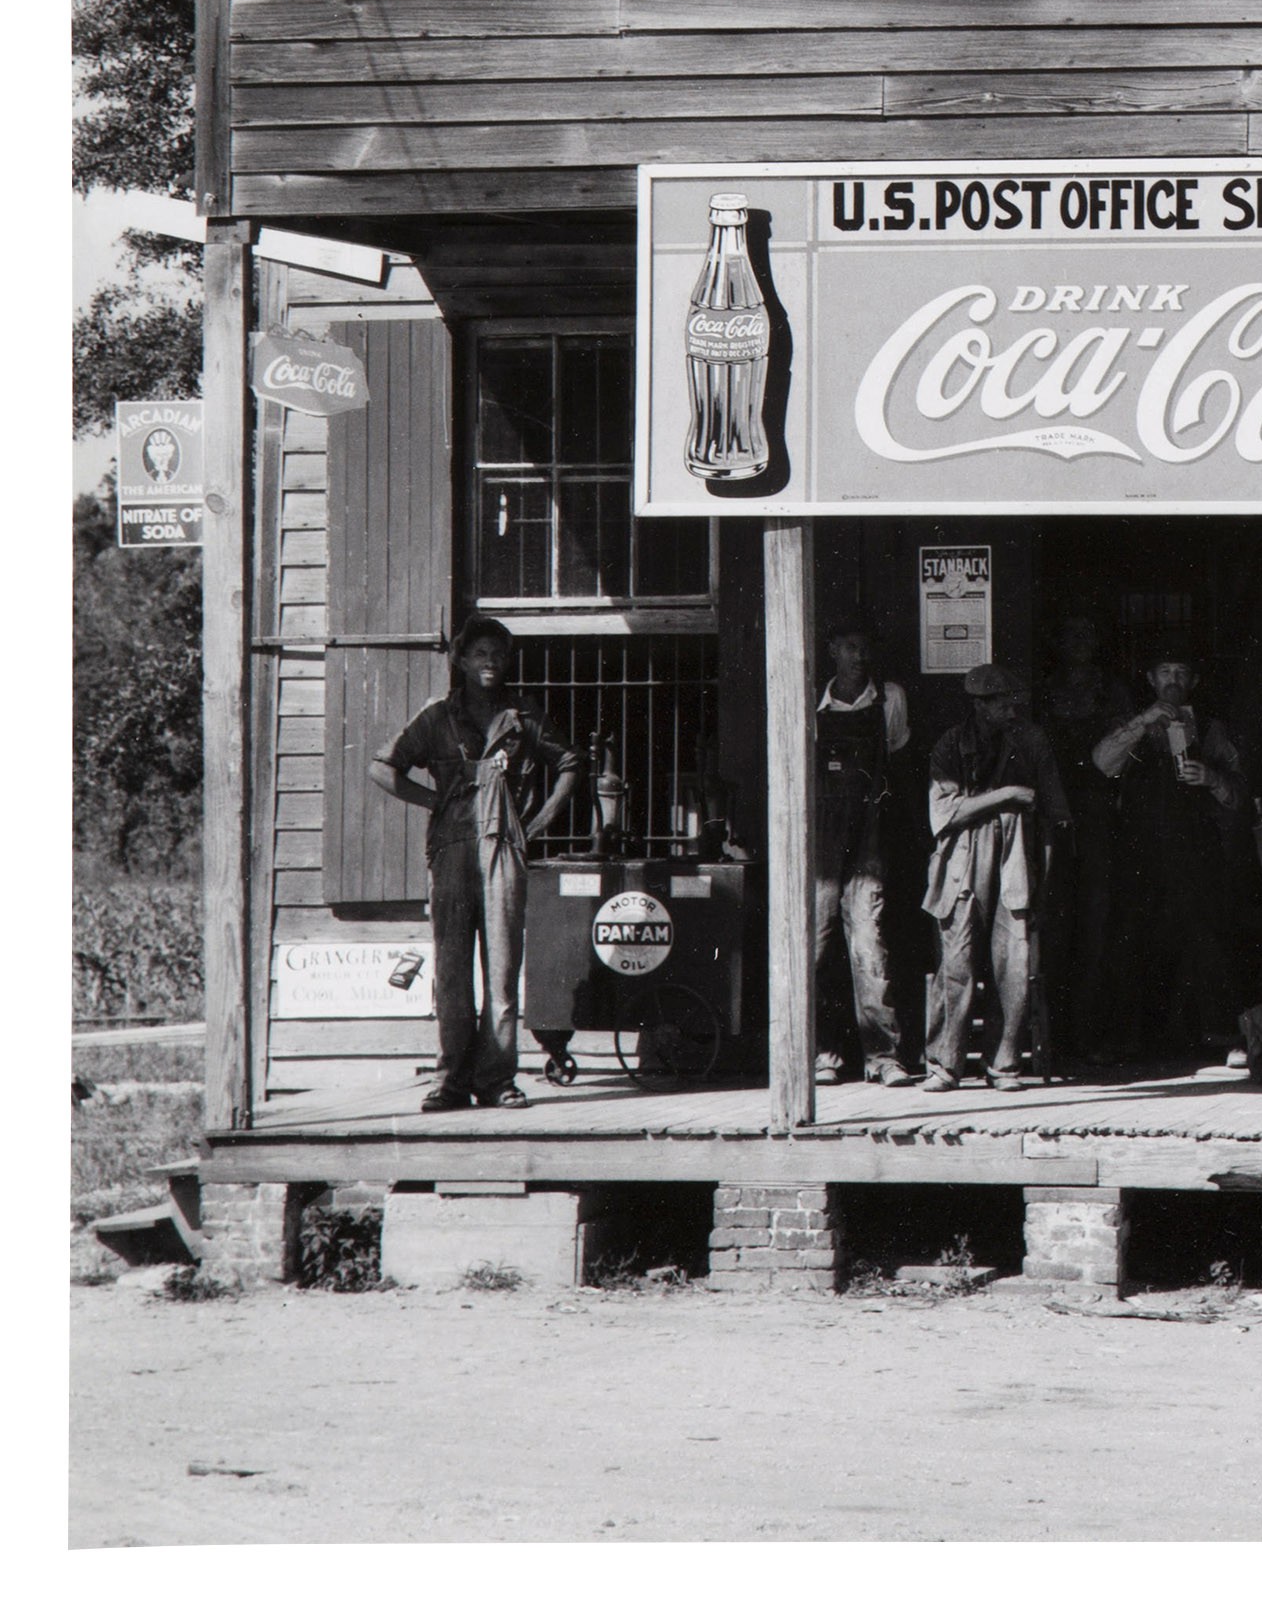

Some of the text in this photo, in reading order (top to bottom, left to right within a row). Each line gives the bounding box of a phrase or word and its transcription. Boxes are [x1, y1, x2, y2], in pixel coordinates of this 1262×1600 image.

[936, 180, 1051, 231] POST
[1060, 180, 1200, 230] OFFICE
[1008, 284, 1191, 311] DRINK
[689, 313, 765, 339] Coca-Cola
[263, 355, 356, 398] Coca-Cola
[120, 408, 201, 437] ARCADIAN
[122, 484, 203, 496] THE AMERICAN
[123, 508, 202, 524] NITRATE OF
[142, 525, 186, 539] SODA
[924, 558, 988, 576] STANBACK
[611, 897, 656, 913] MOTOR
[598, 925, 668, 942] PAN-AM
[286, 945, 382, 971] GRANGER
[621, 960, 646, 970] OIL
